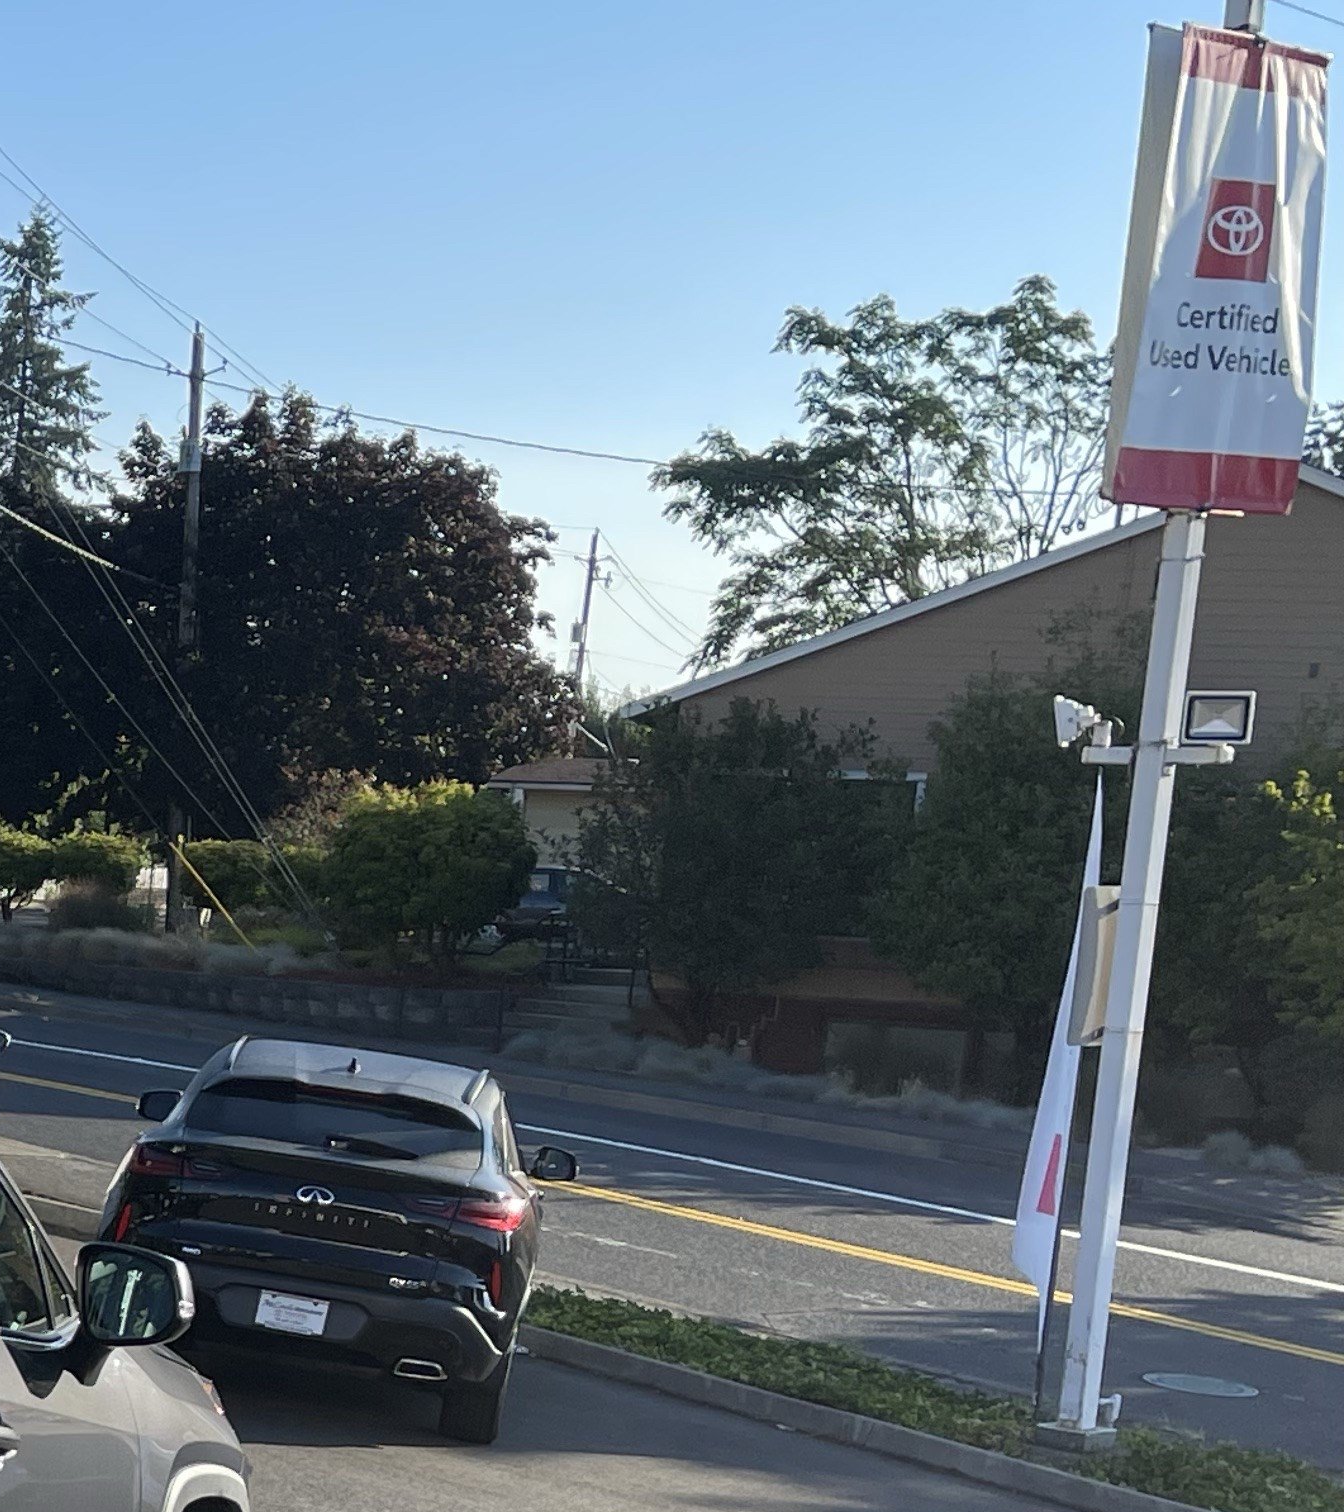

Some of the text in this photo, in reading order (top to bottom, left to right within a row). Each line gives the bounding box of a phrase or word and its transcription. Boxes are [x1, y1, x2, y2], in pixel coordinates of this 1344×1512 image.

[1176, 302, 1279, 334] Certified
[1150, 340, 1295, 377] Used Vehicle
